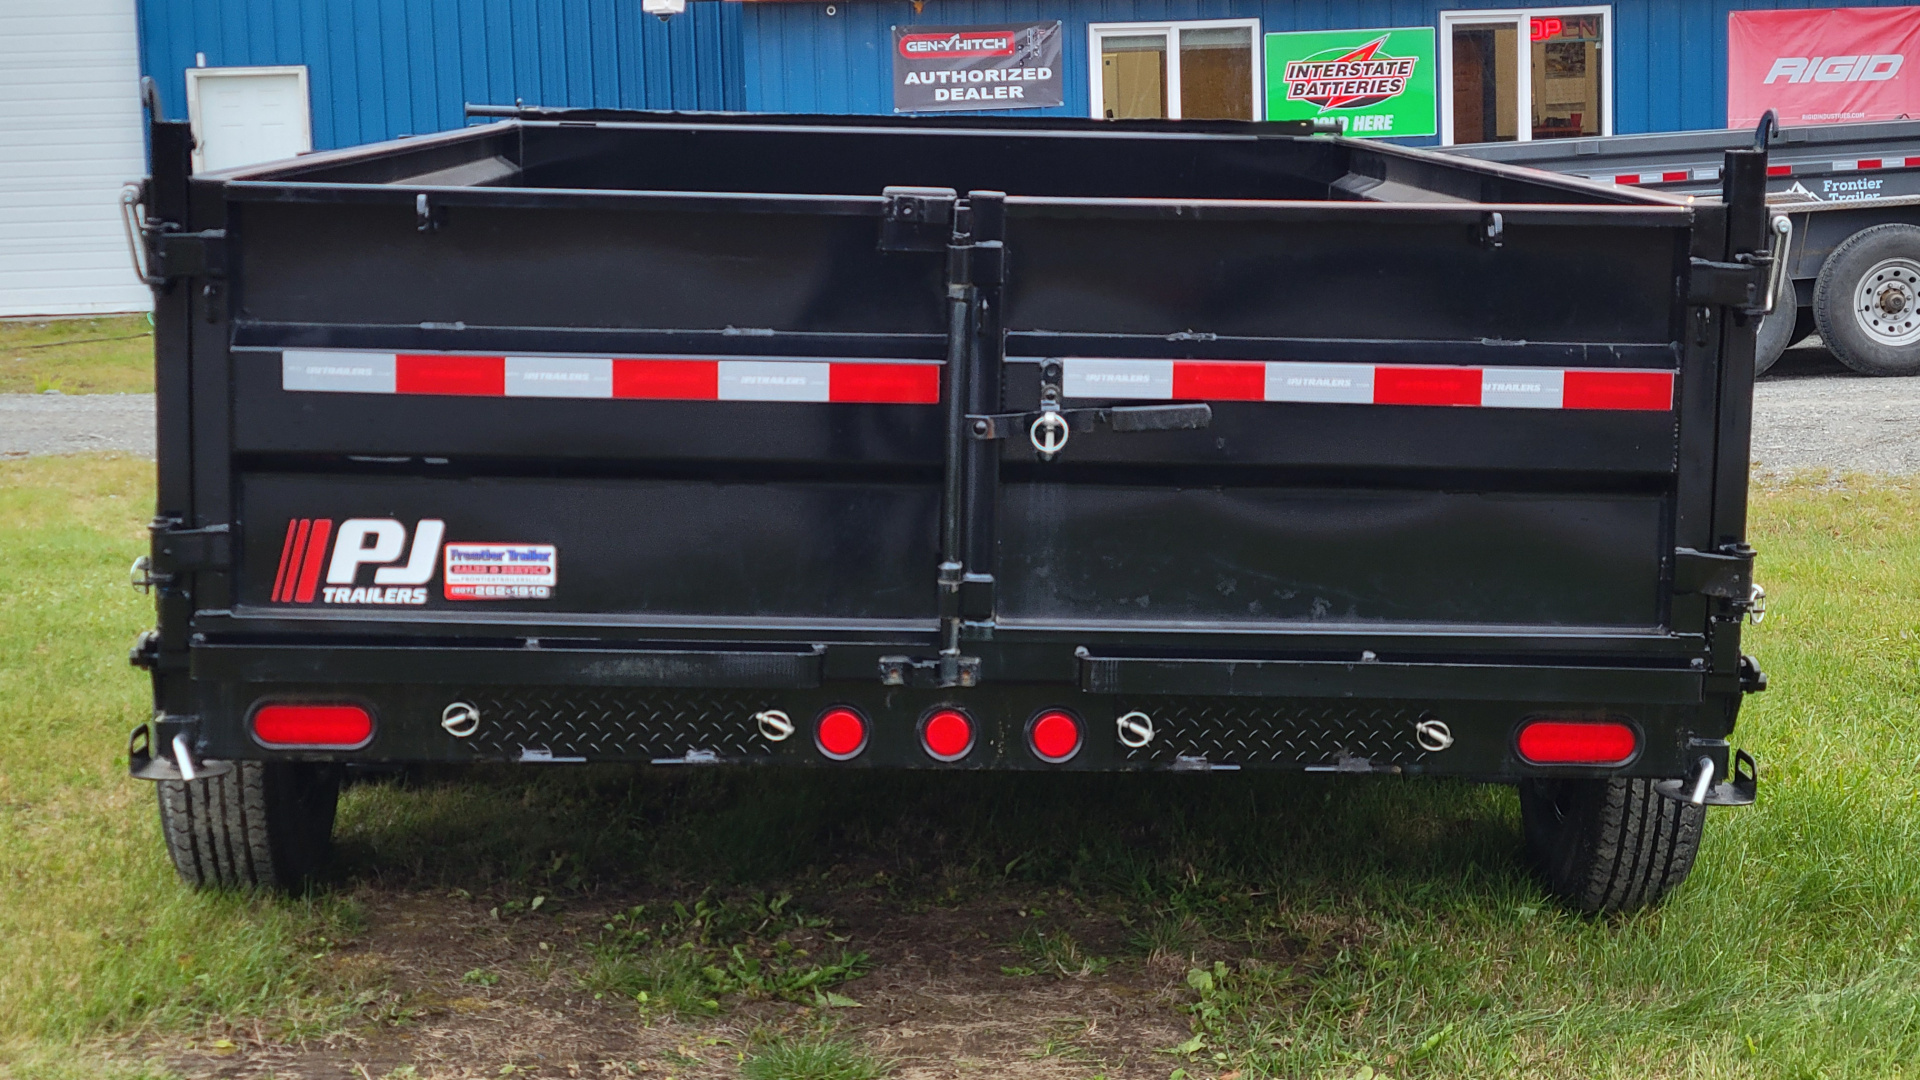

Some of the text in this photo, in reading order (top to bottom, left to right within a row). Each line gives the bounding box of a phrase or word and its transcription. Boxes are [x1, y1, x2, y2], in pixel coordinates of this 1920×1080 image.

[904, 67, 1052, 85] AUTHORIZED
[1289, 61, 1411, 77] INTERSTATE
[1764, 54, 1904, 84] RIGID
[935, 85, 1024, 101] DEALER
[1292, 79, 1402, 96] BATTERIES
[1352, 114, 1394, 132] HERE
[1823, 178, 1883, 192] Frontier
[1491, 383, 1541, 392] TRAILERS
[326, 519, 445, 584] PJ
[323, 586, 427, 604] TRAILERS
